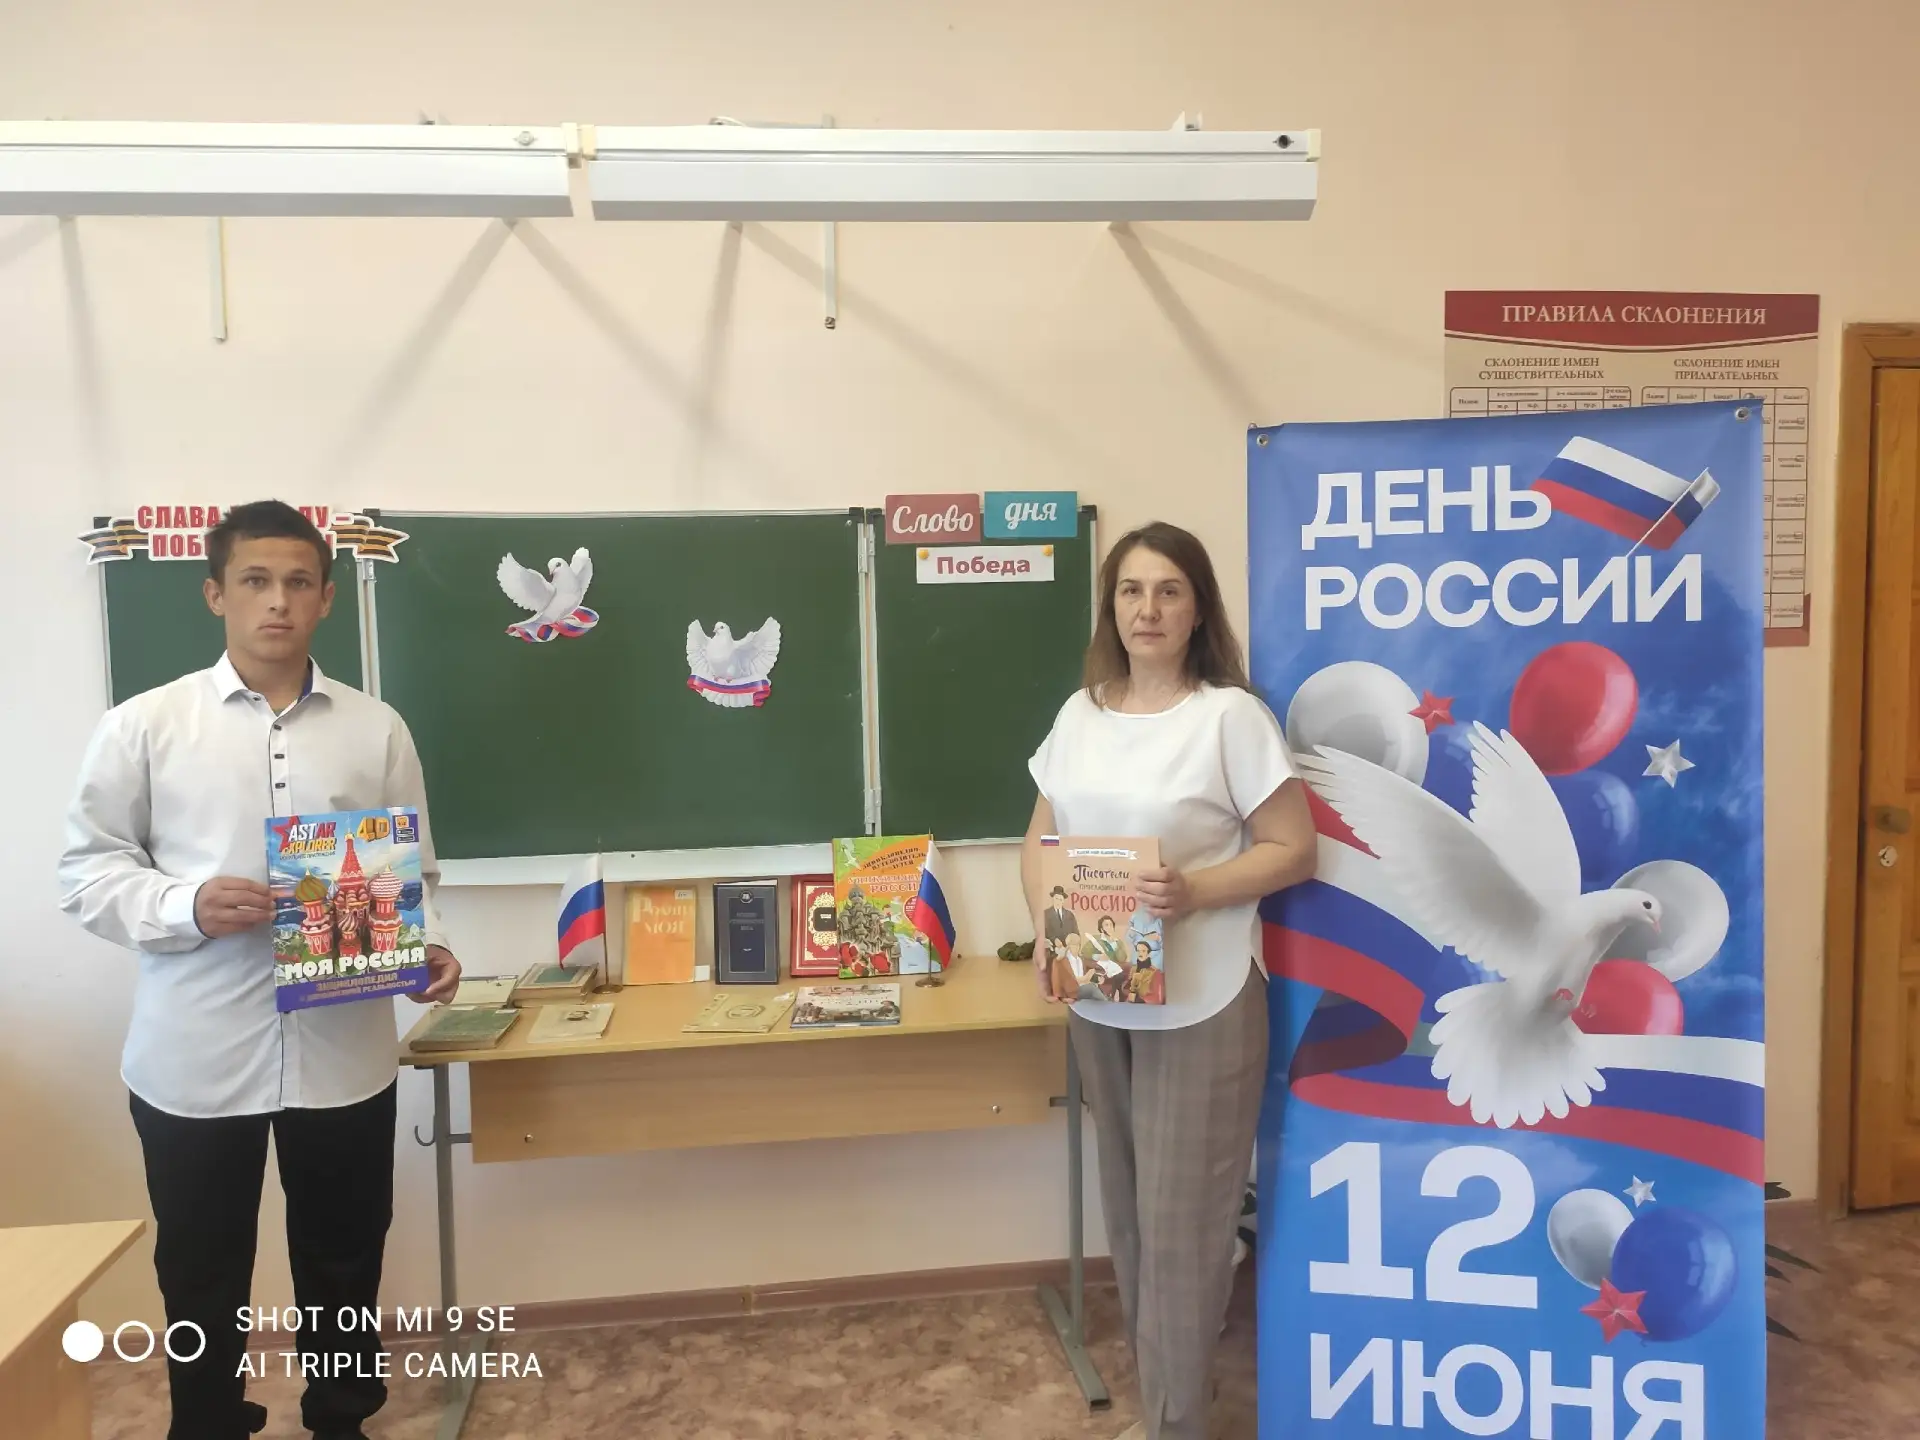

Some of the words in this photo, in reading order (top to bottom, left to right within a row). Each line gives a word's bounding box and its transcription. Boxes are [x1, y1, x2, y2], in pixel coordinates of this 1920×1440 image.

[1502, 305, 1616, 323] ПРАВИЛА
[1621, 305, 1766, 325] СКЛОНЕНИЯ
[1484, 357, 1561, 367] СКЛОНЕНИЕ
[1563, 357, 1600, 367] ИМЕН
[1673, 358, 1744, 369] СКЛОНЕНИЕ
[1746, 359, 1781, 369] ИМЕН
[1478, 370, 1605, 380] СУЩЕСТВИТЕЛЬНЫХ
[1674, 371, 1780, 381] ПРИЛАГАТЕЛЬНЫХ
[137, 505, 220, 529] СЛАВА
[892, 504, 974, 534] Слово
[1004, 502, 1058, 530] дня
[1302, 465, 1552, 550] ДЕНЬ
[936, 556, 1031, 576] Победа
[1305, 553, 1702, 630] РОССИИ
[288, 821, 337, 842] ASTAR
[1070, 891, 1136, 912] РОССИЮ
[284, 958, 334, 980] МОЯ
[338, 946, 426, 973] РОССИЯ
[1309, 1141, 1538, 1309] 12
[1309, 1333, 1705, 1440] ИЮНЯ
